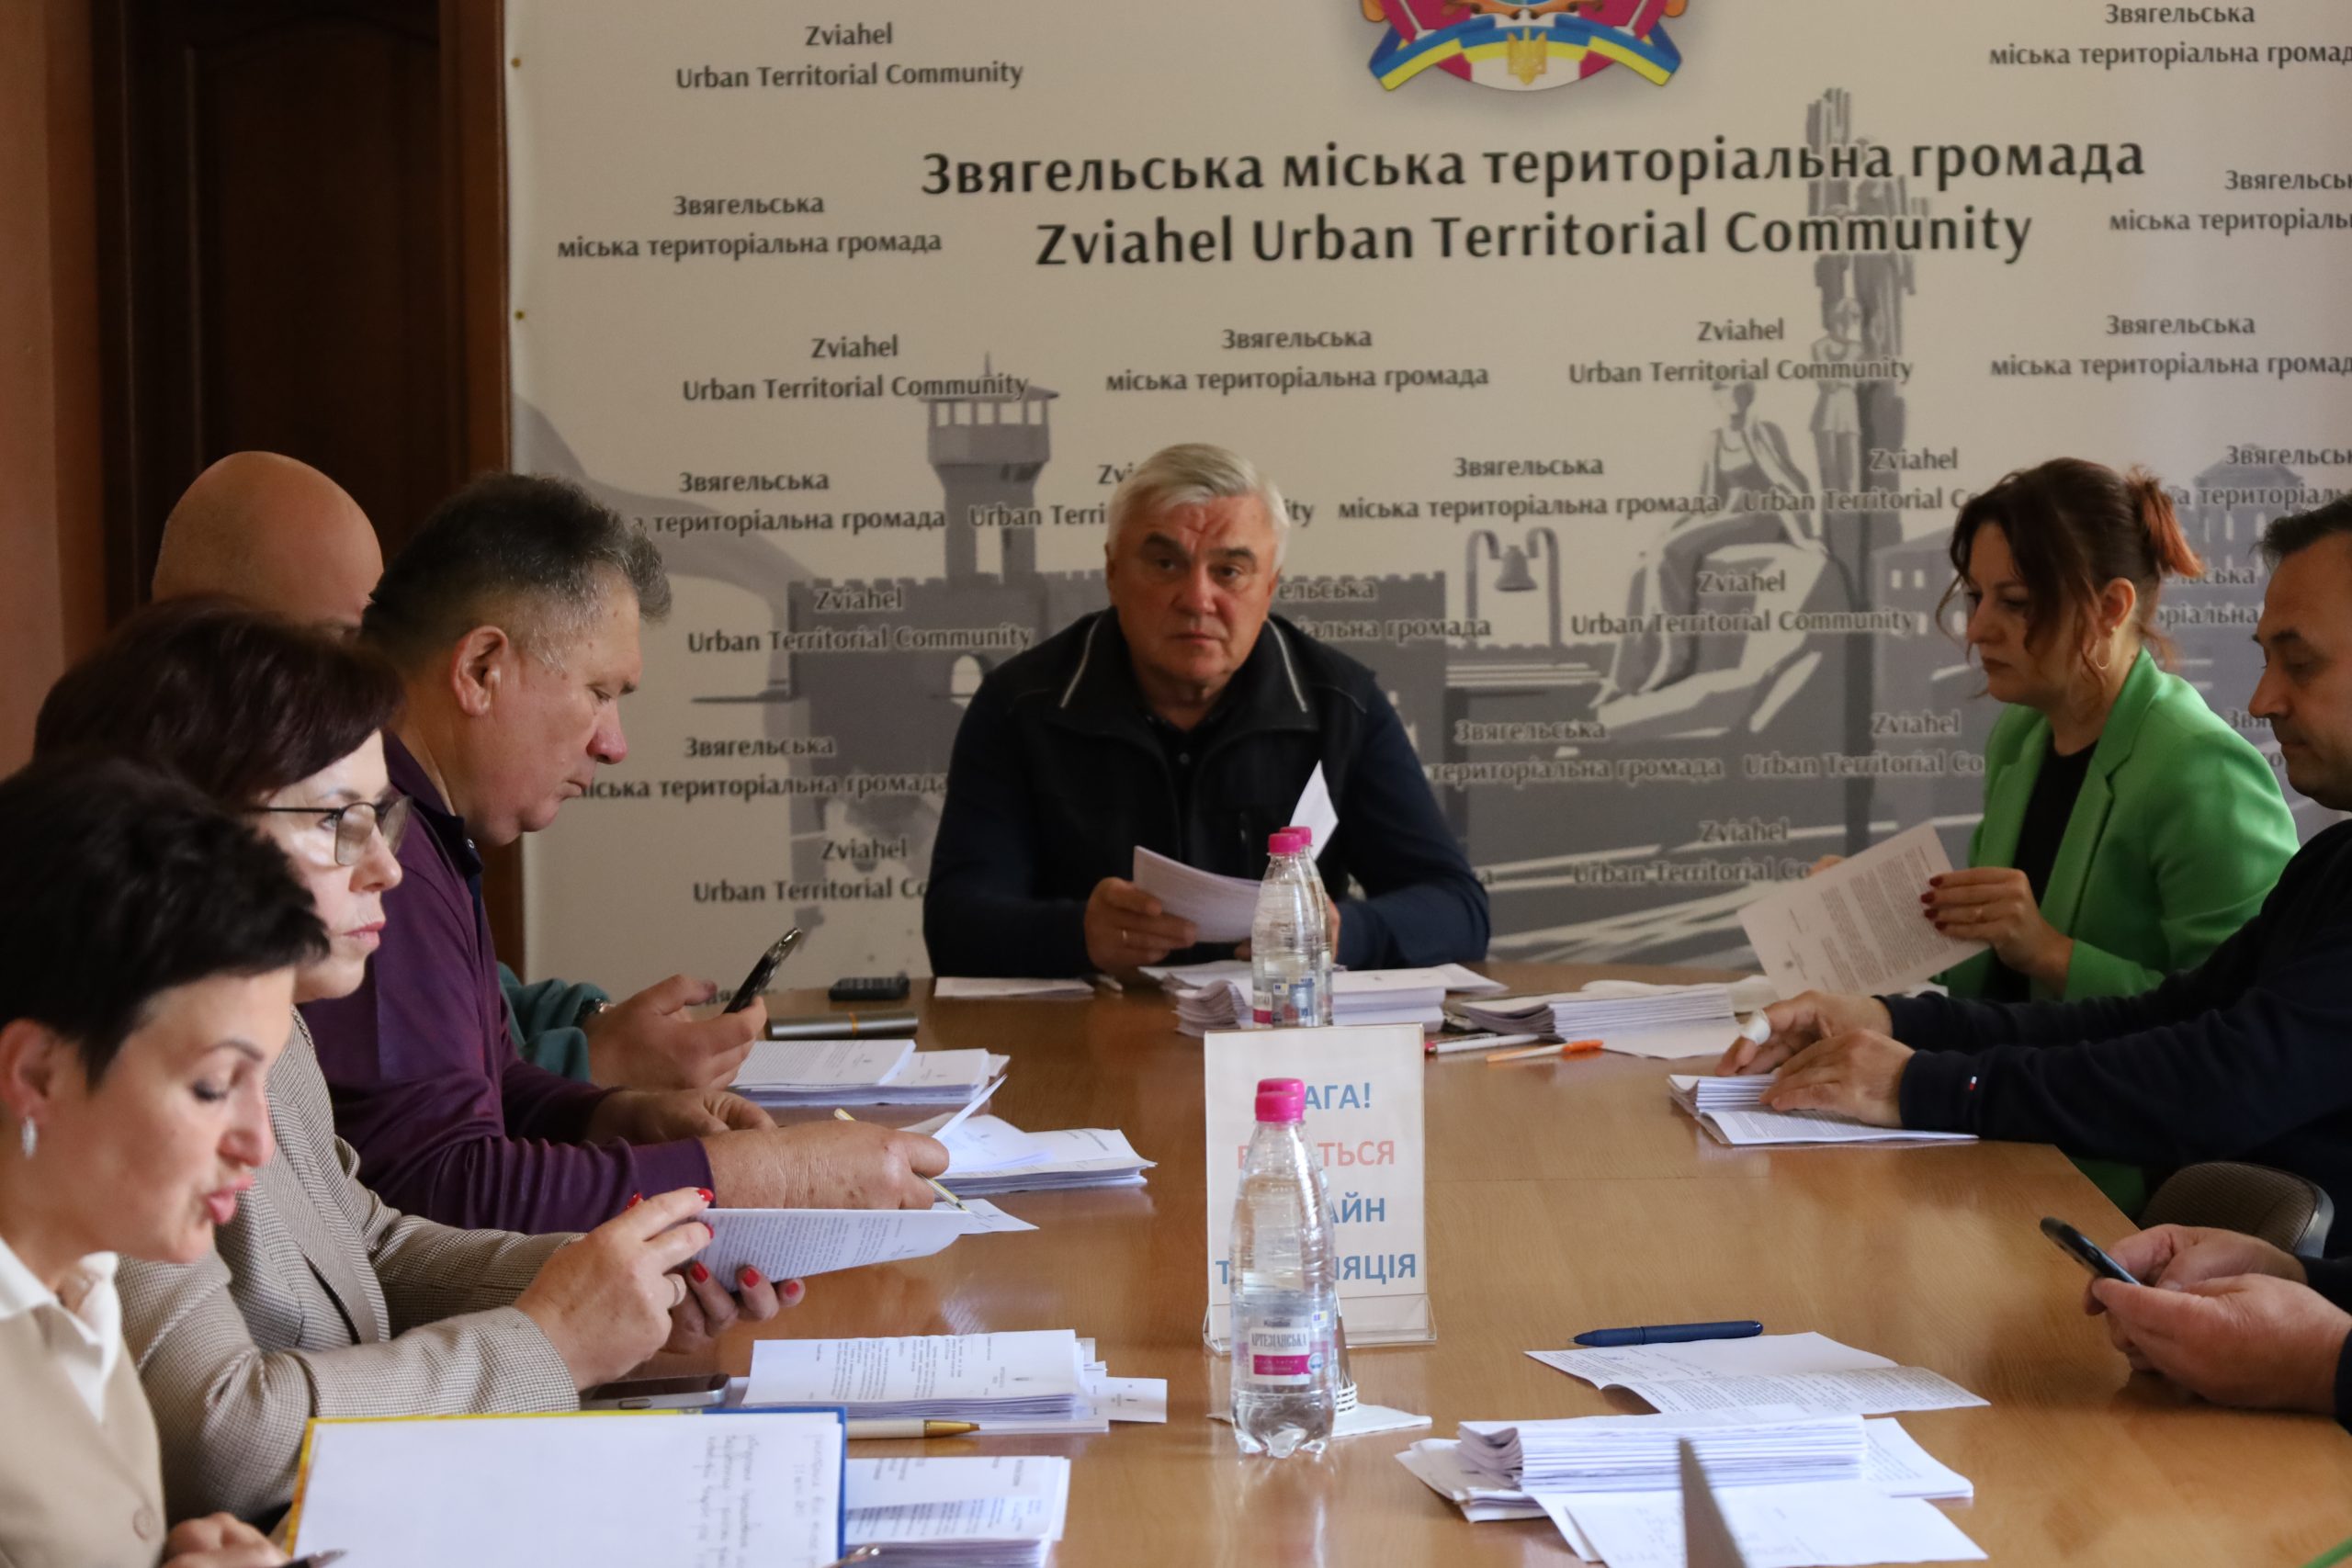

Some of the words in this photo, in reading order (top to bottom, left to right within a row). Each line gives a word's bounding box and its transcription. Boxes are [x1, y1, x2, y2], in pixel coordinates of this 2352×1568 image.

[2105, 4, 2256, 25] Звягельська
[805, 22, 894, 47] Zviahel
[1990, 43, 2071, 65] міська
[2079, 41, 2259, 69] територіальна
[2267, 46, 2352, 69] громад
[676, 66, 749, 88] Urban
[757, 64, 878, 87] Territorial
[887, 62, 1023, 89] Community
[922, 152, 1263, 195] Звягельська
[1283, 141, 1465, 189] міська
[1483, 135, 1894, 197] територіальна
[1912, 141, 2146, 191] громада
[2224, 169, 2352, 190] Звягельсь
[673, 194, 825, 217] Звягельська
[2109, 209, 2190, 231] міська
[2199, 207, 2352, 236] територіаль
[557, 234, 639, 258] міська
[648, 232, 829, 262] територіальна
[837, 231, 943, 259] громада
[1035, 215, 1233, 265] Zviahel
[1253, 214, 1414, 262] Urban
[1431, 208, 1707, 260] Territorial
[1725, 208, 2033, 264] Community
[1221, 327, 1373, 350] Звягельська
[1697, 318, 1784, 342] Zviahel
[2105, 315, 2256, 338] Звягельська
[811, 334, 899, 358] Zviahel
[1569, 360, 1643, 383] Urban
[1649, 357, 1769, 381] Territorial
[1777, 355, 1914, 384] Community
[1990, 355, 2072, 378] міська
[2079, 352, 2259, 381] територіальна
[2267, 356, 2352, 380] громад
[683, 378, 757, 401] Urban
[763, 376, 883, 400] Territorial
[891, 373, 1028, 401] Community
[1106, 369, 1188, 393] міська
[1194, 366, 1376, 396] територіальна
[1385, 366, 1489, 393] громада
[1454, 457, 1604, 478] Звягельська
[1870, 447, 1959, 470] Zviahel
[2226, 446, 2352, 465] Звягельсь
[678, 470, 830, 493] Звягельська
[1339, 496, 1420, 521] міська
[1429, 492, 1609, 524] територіальна
[1615, 491, 1721, 520] громада
[1745, 490, 1816, 513] Urban
[1823, 486, 1942, 512] Territorial
[654, 506, 833, 537] територіальна
[842, 505, 946, 533] громада
[970, 504, 1042, 527] Urban
[1279, 581, 1374, 599] ельська
[1699, 570, 1786, 593] Zviahel
[815, 589, 902, 612] Zviahel
[1386, 617, 1491, 643] громада
[1571, 614, 1645, 637] Urban
[1650, 611, 1770, 635] Territorial
[1778, 609, 1915, 637] Community
[688, 630, 760, 653] Urban
[769, 627, 888, 652] Territorial
[896, 624, 1032, 651] Community
[1457, 721, 1606, 741] Звягельська
[1872, 712, 1961, 735] Zviahel
[685, 736, 834, 758] Звягельська
[1617, 756, 1723, 783] громада
[660, 775, 837, 803] територіальна
[821, 838, 907, 860] Zviahel
[694, 881, 764, 903] Urban
[776, 876, 892, 902] Territorial
[1305, 1083, 1370, 1110] АГА!
